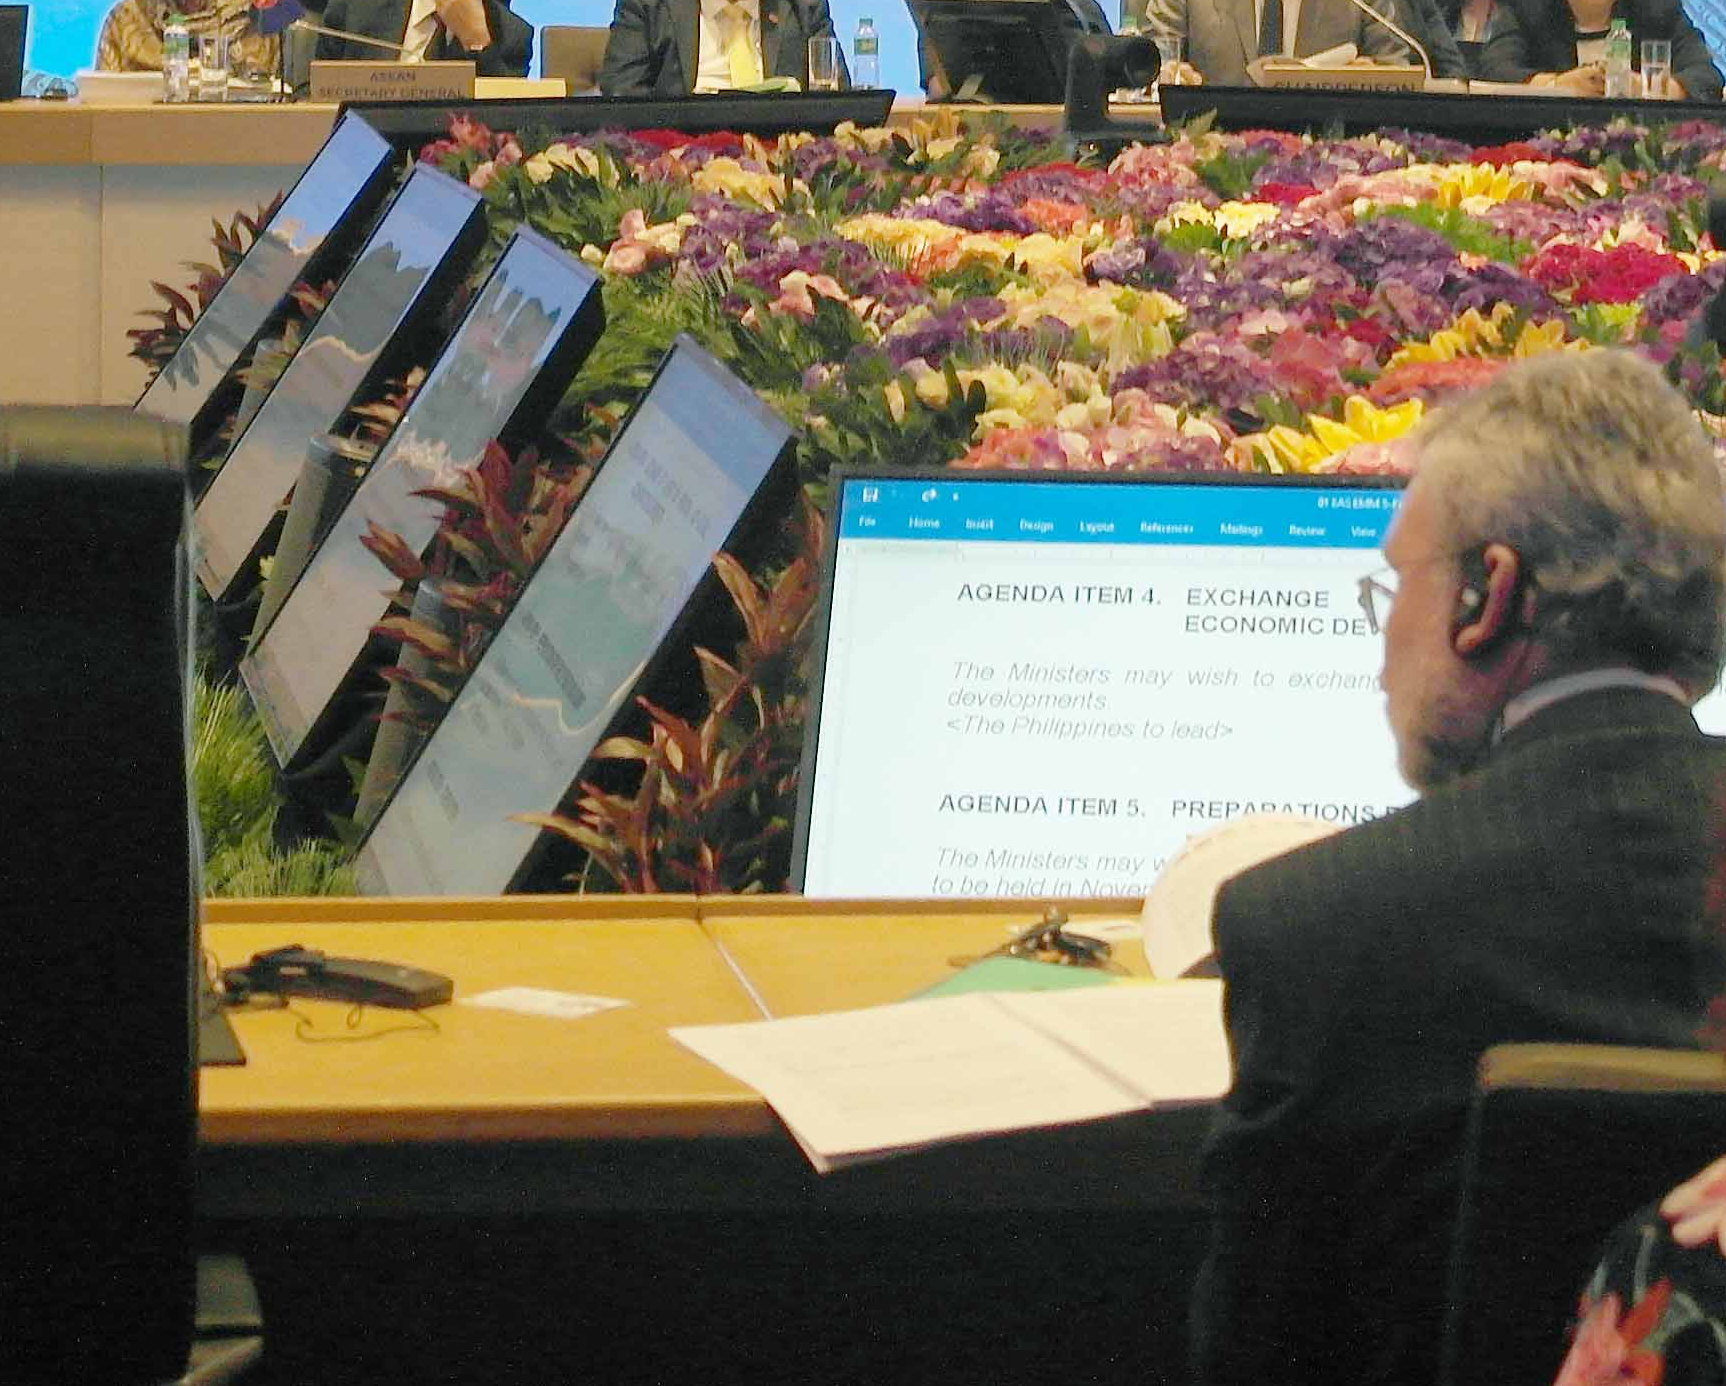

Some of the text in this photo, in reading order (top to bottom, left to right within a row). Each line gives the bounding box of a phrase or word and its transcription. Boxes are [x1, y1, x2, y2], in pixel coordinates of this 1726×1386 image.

[370, 71, 416, 83] ASEAN
[908, 517, 940, 529] Home
[1019, 519, 1054, 533] Design
[1079, 521, 1115, 534] Layout
[1139, 522, 1195, 535] References
[1220, 524, 1264, 538] Mailings
[1288, 525, 1325, 537] Review
[1351, 525, 1377, 537] View
[958, 584, 1064, 601] AGENDA
[1075, 587, 1132, 603] ITEM
[1142, 588, 1160, 604] 4.
[1188, 589, 1327, 607] EXCHANGE
[1186, 616, 1323, 634] ECONOMIC
[955, 662, 994, 680] The
[1008, 662, 1110, 683] Ministers
[1125, 670, 1172, 687] may
[1188, 668, 1237, 686] wish
[1254, 670, 1274, 686] to
[947, 715, 1232, 739] <The Philippines to lead>
[939, 795, 1047, 813] AGENDA
[1059, 798, 1116, 814] ITEM
[939, 848, 978, 867] The
[986, 849, 1088, 869] Ministers
[1097, 857, 1144, 875] may
[932, 874, 954, 894] to
[960, 876, 988, 895] be
[995, 877, 1046, 897] held
